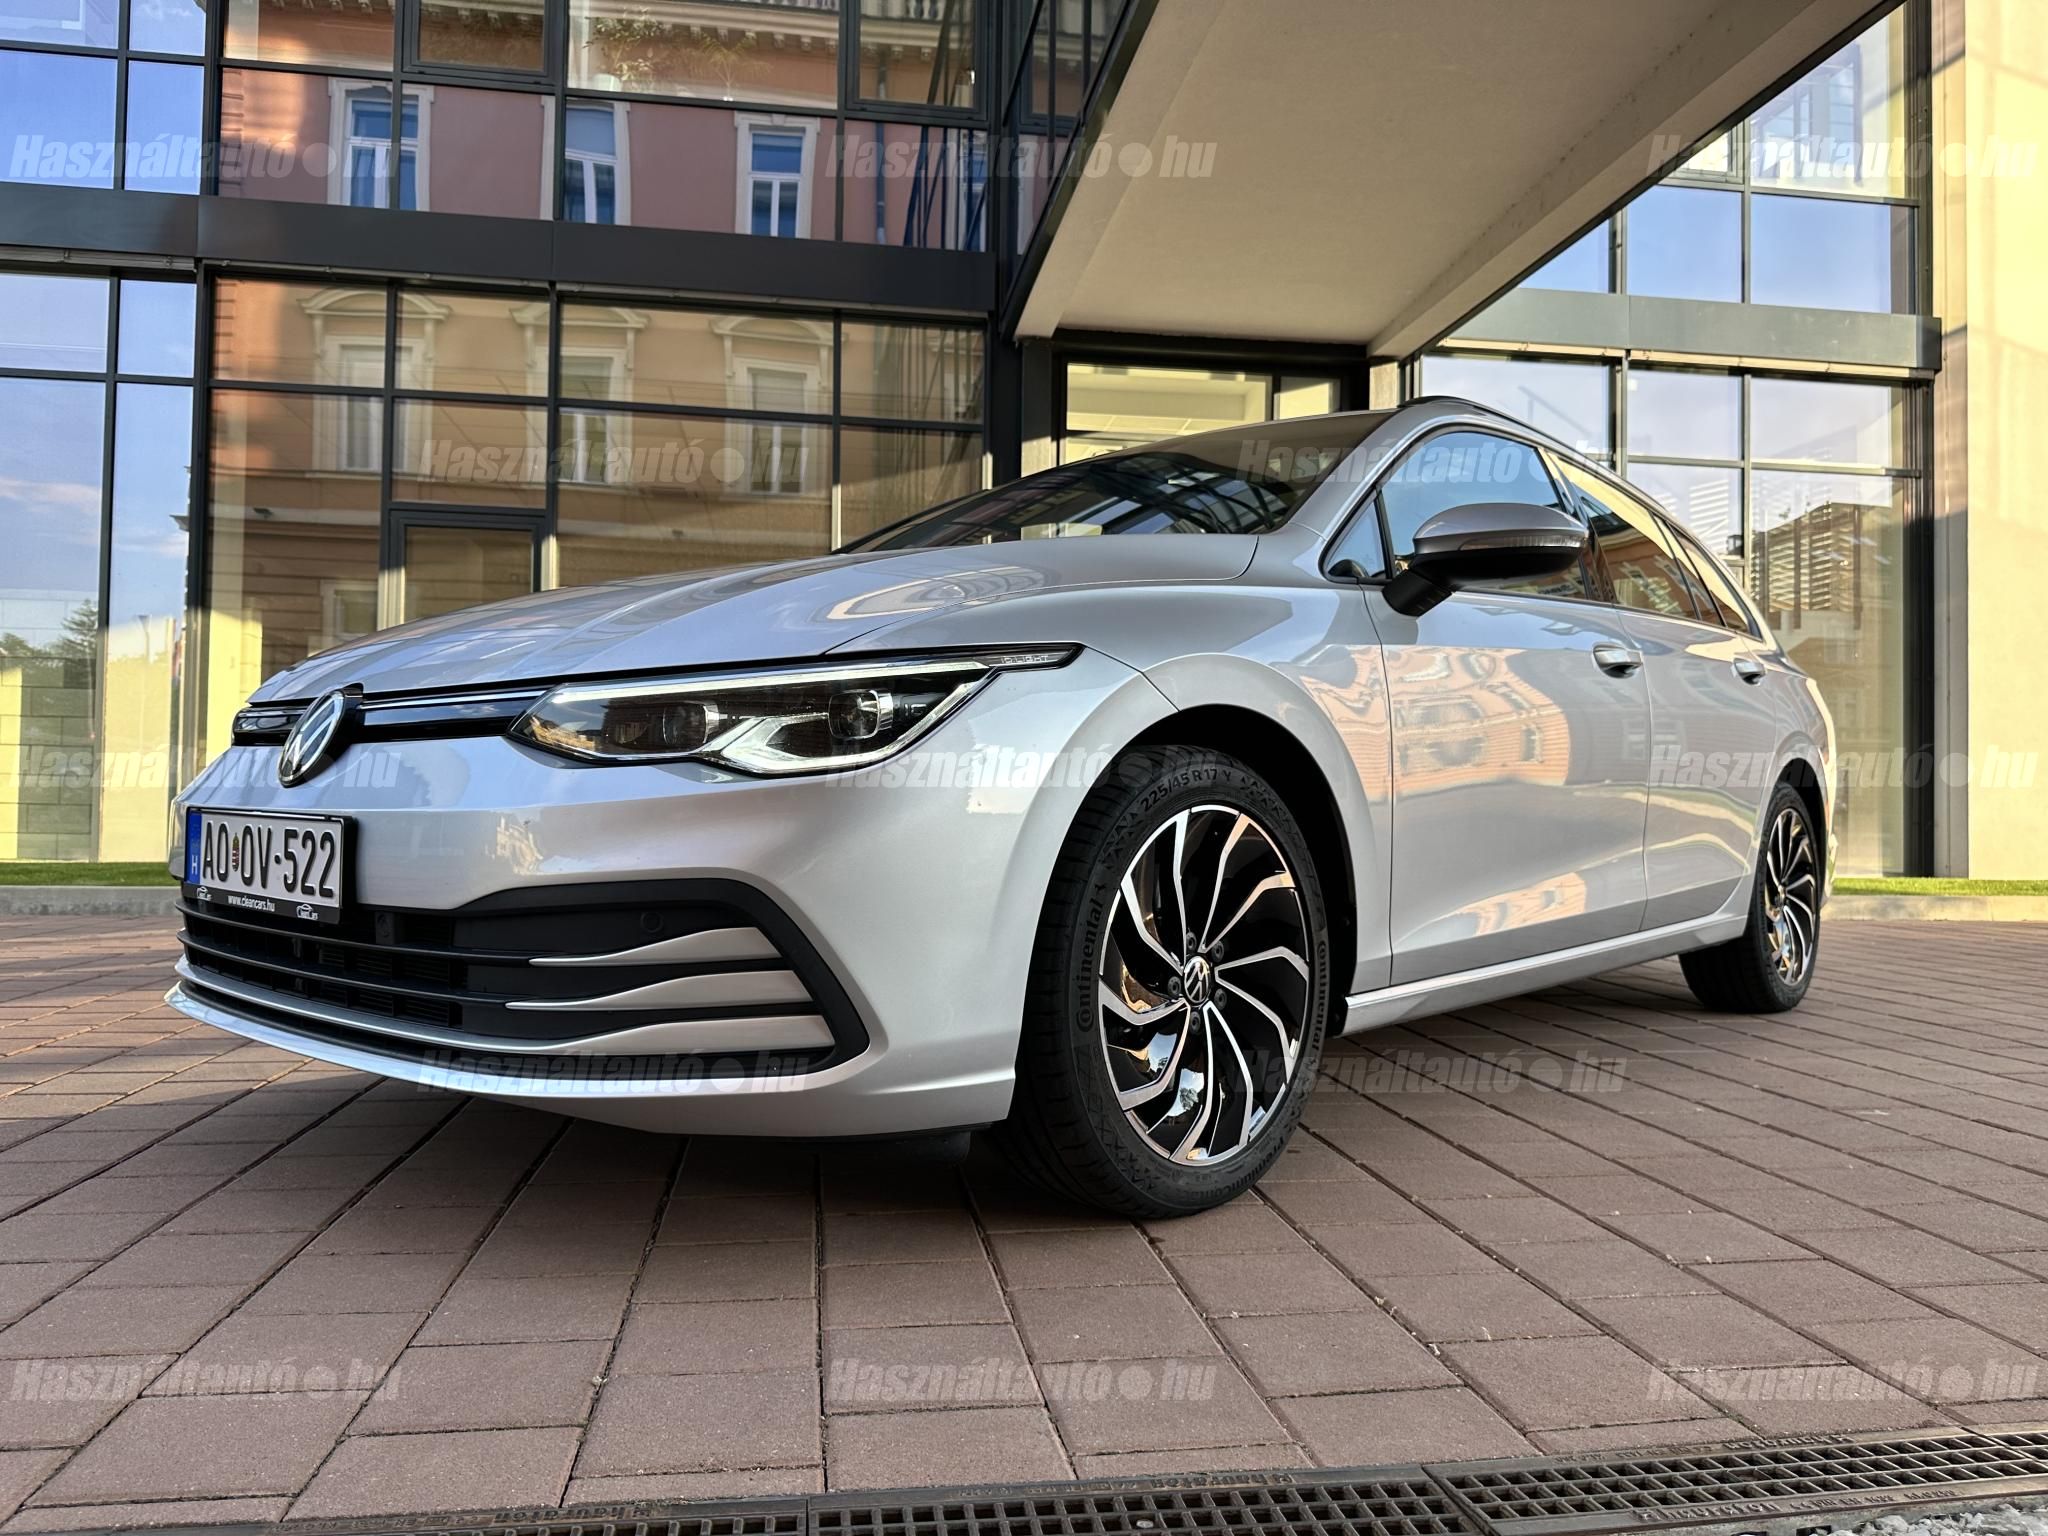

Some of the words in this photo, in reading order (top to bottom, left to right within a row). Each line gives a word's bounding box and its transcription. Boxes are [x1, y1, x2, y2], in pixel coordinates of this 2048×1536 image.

[1141, 773, 1190, 812] 225/45
[1223, 770, 1231, 782] Y
[202, 821, 230, 882] AO
[228, 895, 276, 912] www.cleancars.hu
[1076, 898, 1104, 1033] Continental
[1311, 940, 1328, 1051] Continental
